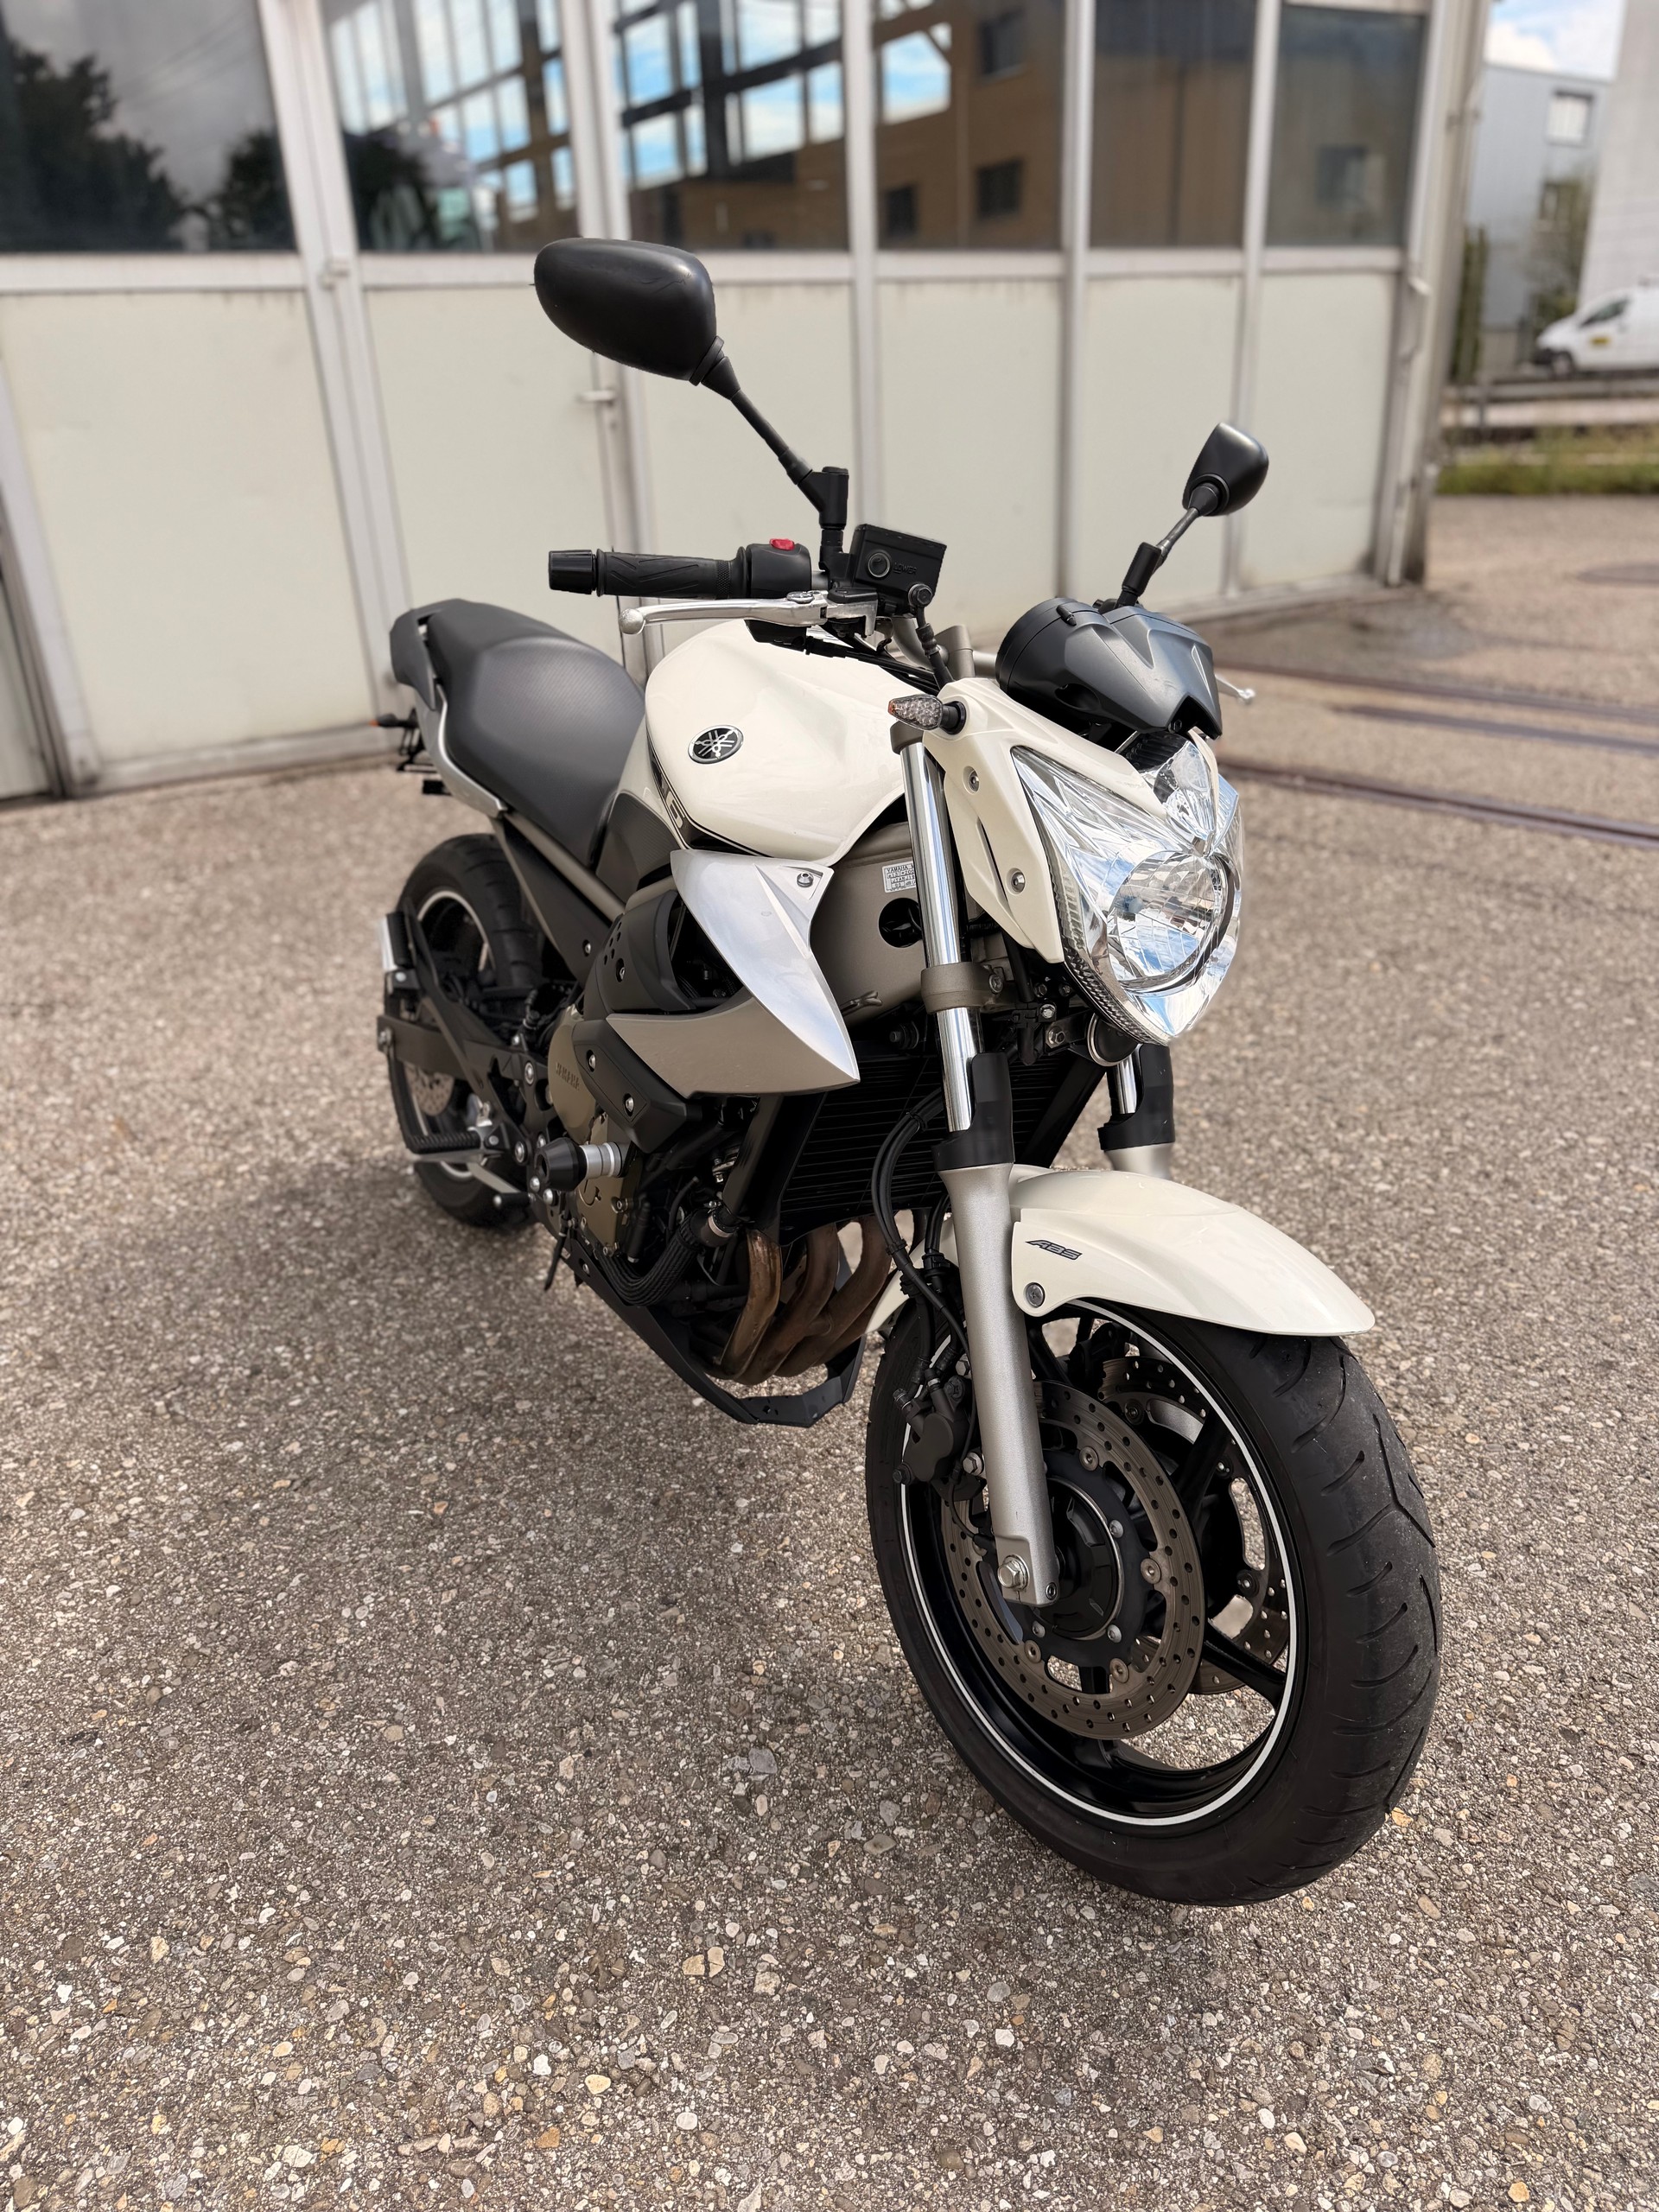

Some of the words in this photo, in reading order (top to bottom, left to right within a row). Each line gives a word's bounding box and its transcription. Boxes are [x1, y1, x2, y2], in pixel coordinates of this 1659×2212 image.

[893, 562, 917, 575] LOWER
[556, 1062, 580, 1091] YAMAHA
[1026, 1240, 1083, 1261] ABS
